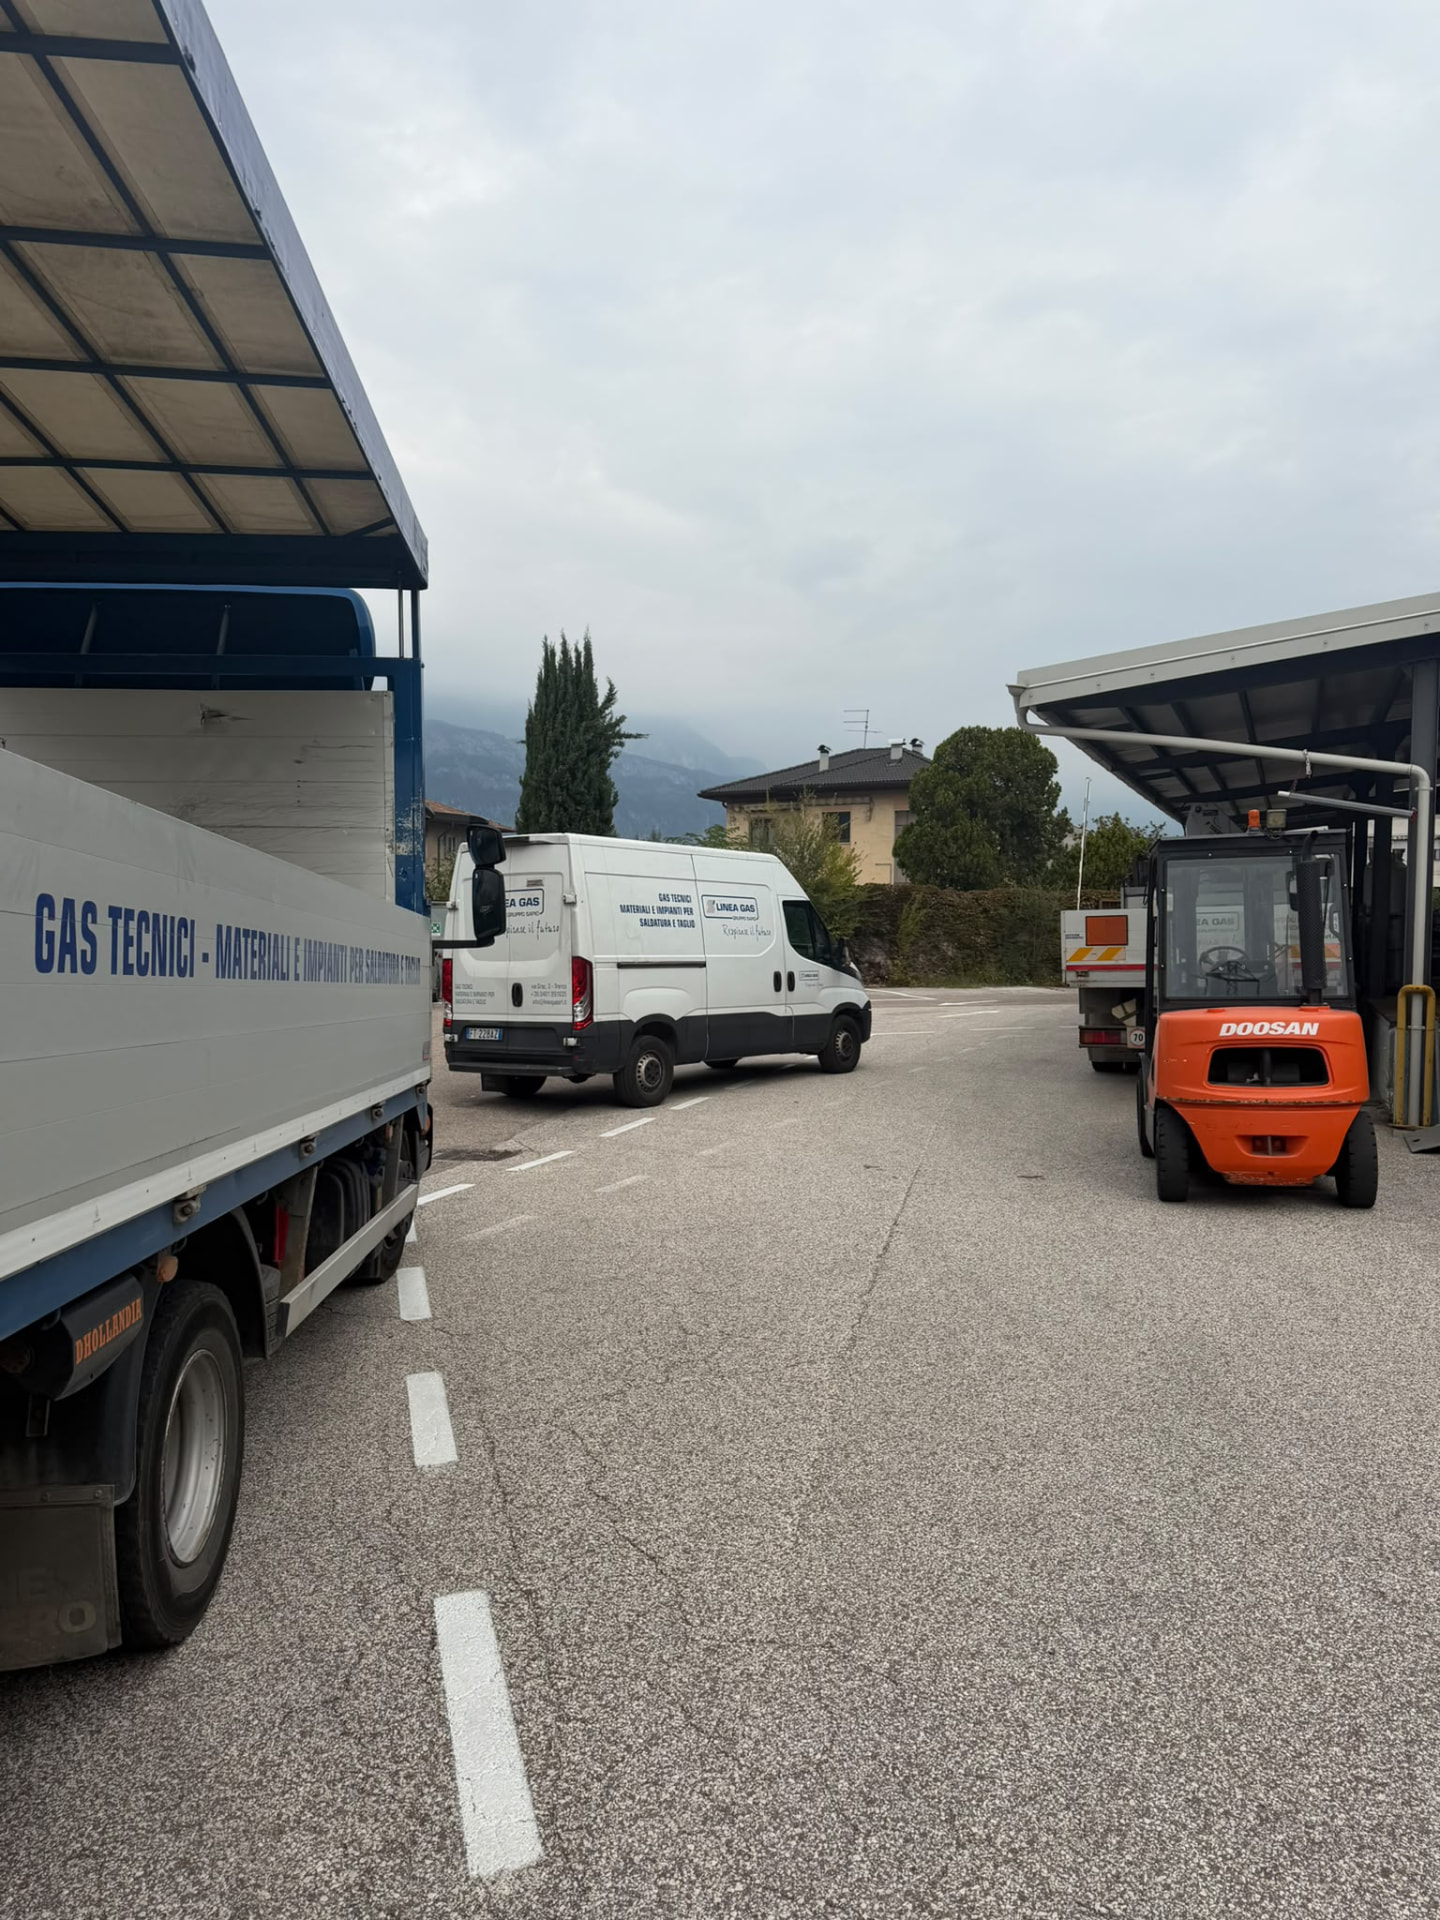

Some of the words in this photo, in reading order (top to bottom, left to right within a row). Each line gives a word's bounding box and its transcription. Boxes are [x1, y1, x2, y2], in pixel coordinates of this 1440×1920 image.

[519, 897, 540, 907] GAS
[659, 893, 670, 903] GAS
[671, 893, 691, 903] TECNICI
[620, 904, 650, 914] MATERIALI
[652, 905, 656, 914] E
[657, 905, 682, 915] IMPIANTI
[684, 906, 694, 916] PER
[716, 903, 738, 912] LINEA
[740, 904, 755, 912] GAS
[640, 918, 671, 928] SALDATURA
[672, 919, 676, 927] E
[677, 919, 695, 928] TAGLIO
[35, 892, 98, 975] GAS
[108, 904, 195, 978] TECNICI
[216, 923, 291, 981] MATERIALI
[294, 937, 300, 981] E
[304, 938, 348, 983] IMPIANTI
[350, 946, 364, 984] PER
[366, 948, 400, 984] SALDATURA
[1219, 1021, 1319, 1036] DOOSAN
[1133, 1033, 1143, 1042] 70
[75, 1297, 142, 1365] DHOLLANDIA
